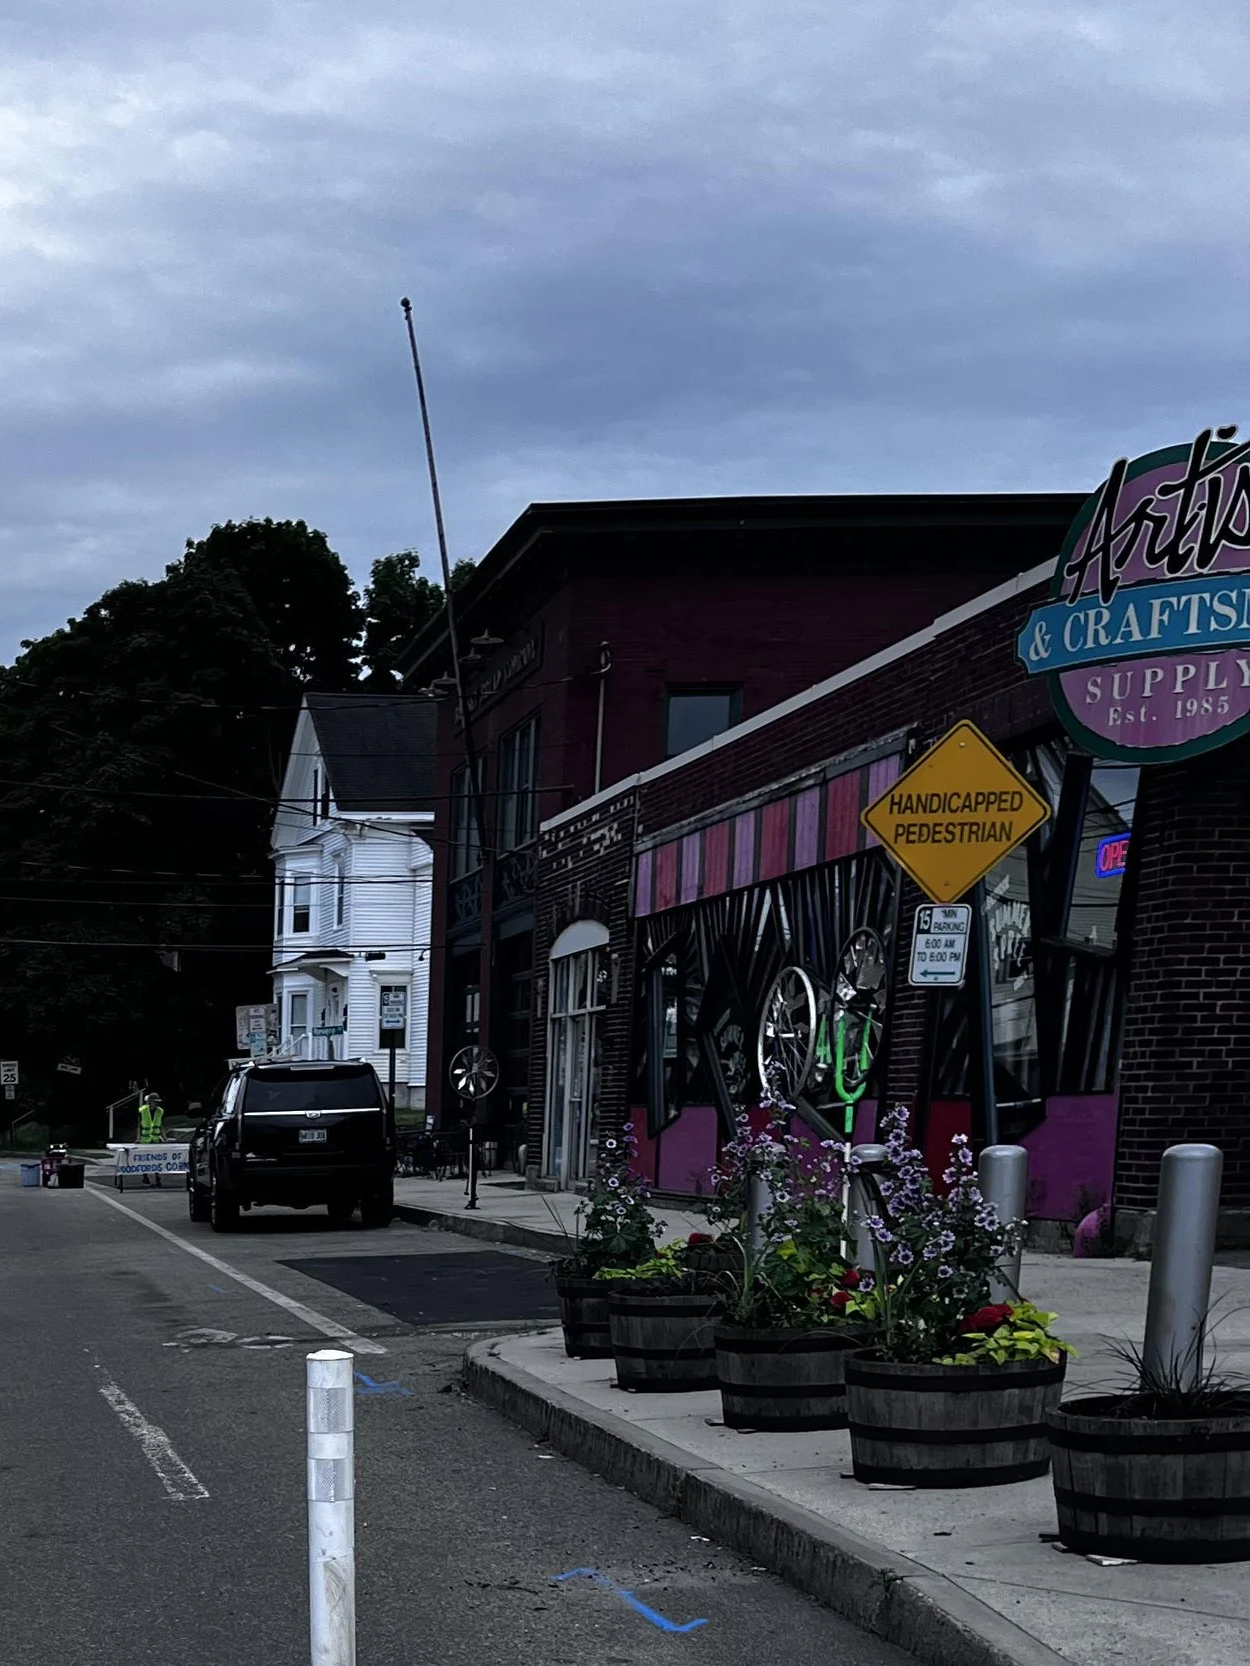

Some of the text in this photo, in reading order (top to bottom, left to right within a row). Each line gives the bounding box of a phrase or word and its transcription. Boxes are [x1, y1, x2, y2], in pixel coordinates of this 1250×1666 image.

[1029, 587, 1250, 661] & CRAFTS
[1108, 696, 1230, 726] Est. 1985
[888, 789, 1024, 815] HANDICAPPED
[894, 821, 1013, 845] PEDESTRIAN
[919, 910, 931, 930] 15
[933, 922, 965, 931] PARKING
[944, 938, 956, 949] AM
[917, 951, 927, 962] TO
[950, 951, 961, 962] PM
[3, 1073, 16, 1083] 25
[133, 1152, 182, 1162] FRIENDS OF
